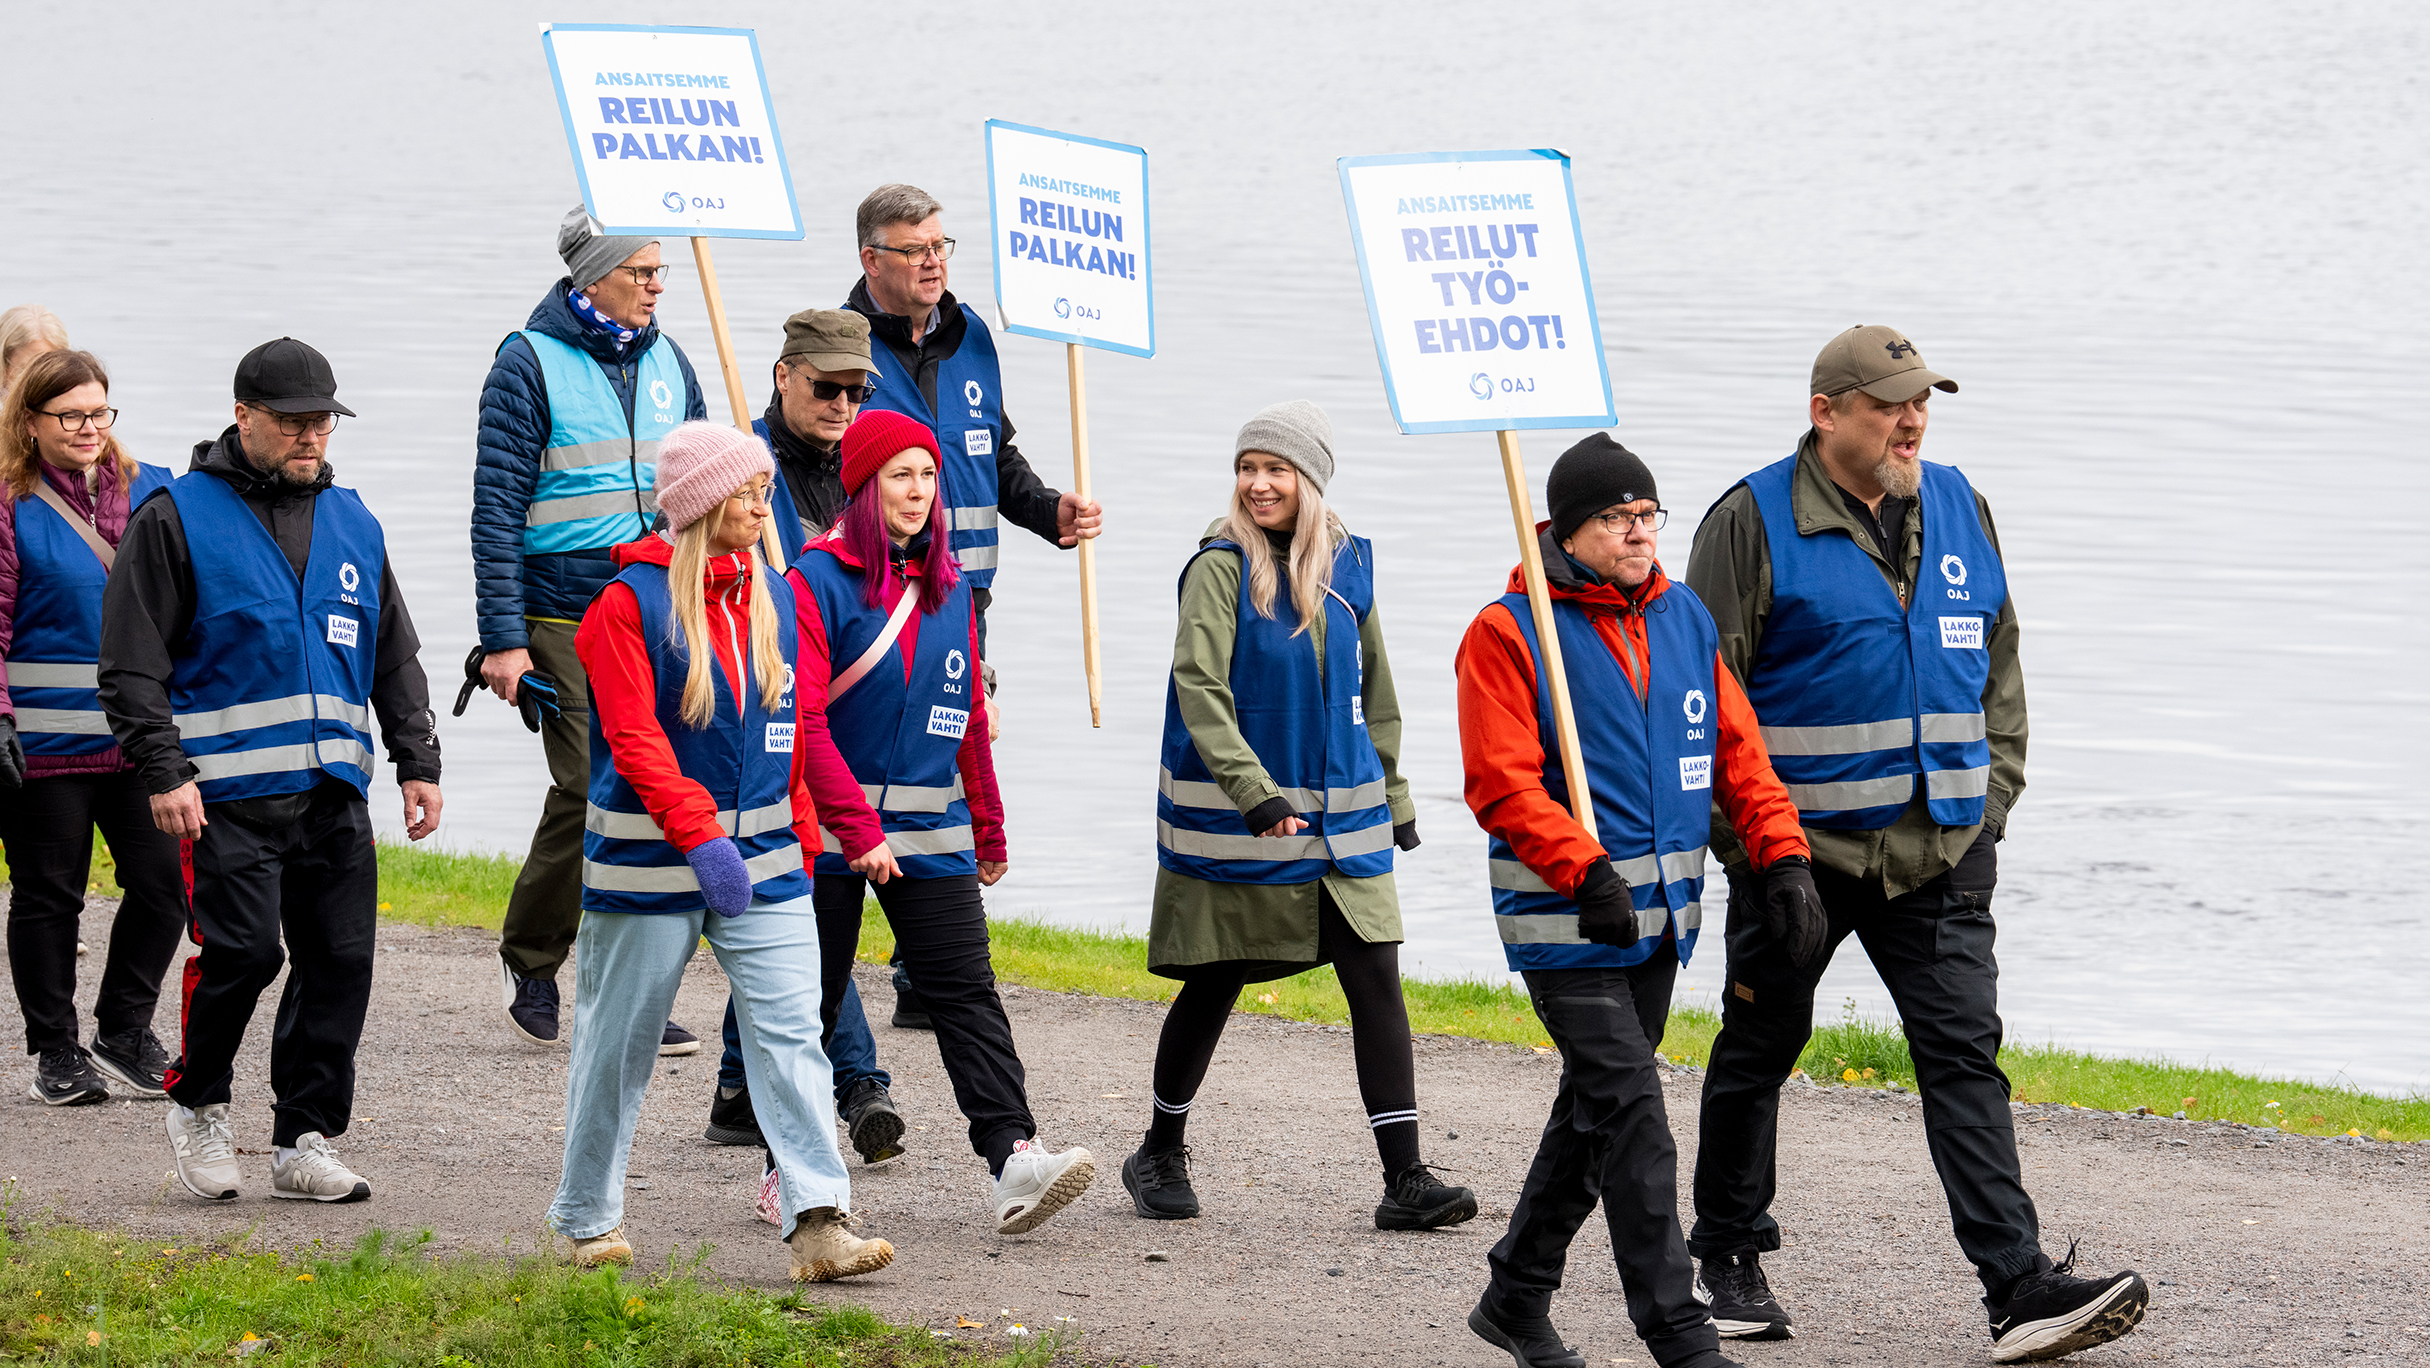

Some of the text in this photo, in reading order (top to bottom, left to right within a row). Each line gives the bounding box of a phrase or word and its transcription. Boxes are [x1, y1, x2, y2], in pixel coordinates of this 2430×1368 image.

[595, 72, 730, 89] ANSAITSEMME
[598, 97, 740, 127] REILUN
[591, 132, 764, 164] PALKAN!
[1019, 172, 1121, 204] ANSAITSEMME
[692, 197, 725, 210] OAJ
[1397, 193, 1534, 215] ANSAITSEMME
[1019, 197, 1123, 242] REILUN
[1401, 223, 1539, 262] REILUT
[1009, 230, 1136, 281] PALKAN!
[1431, 260, 1529, 307] TYÖ-
[1076, 306, 1101, 320] OAJ
[1413, 314, 1566, 354] EHDOT!
[1500, 377, 1535, 393] OAJ
[654, 413, 674, 424] OAJ
[969, 409, 982, 418] OAJ
[969, 443, 986, 451] VAHTI
[340, 593, 359, 605] OAJ
[1946, 588, 1970, 601] OAJ
[332, 619, 356, 632] LAKKO-
[1943, 621, 1981, 632] LAKKO-
[332, 630, 354, 643] VAHTI
[1945, 633, 1977, 644] VAHTI
[943, 682, 962, 695] OAJ
[933, 709, 967, 724] LAKKO-
[931, 721, 961, 734] VAHTI
[1686, 728, 1704, 741] OAJ
[769, 739, 793, 748] VAHTI
[1683, 760, 1709, 772] LAKKO-
[1684, 774, 1705, 785] VAHTI
[292, 1169, 313, 1193] N
